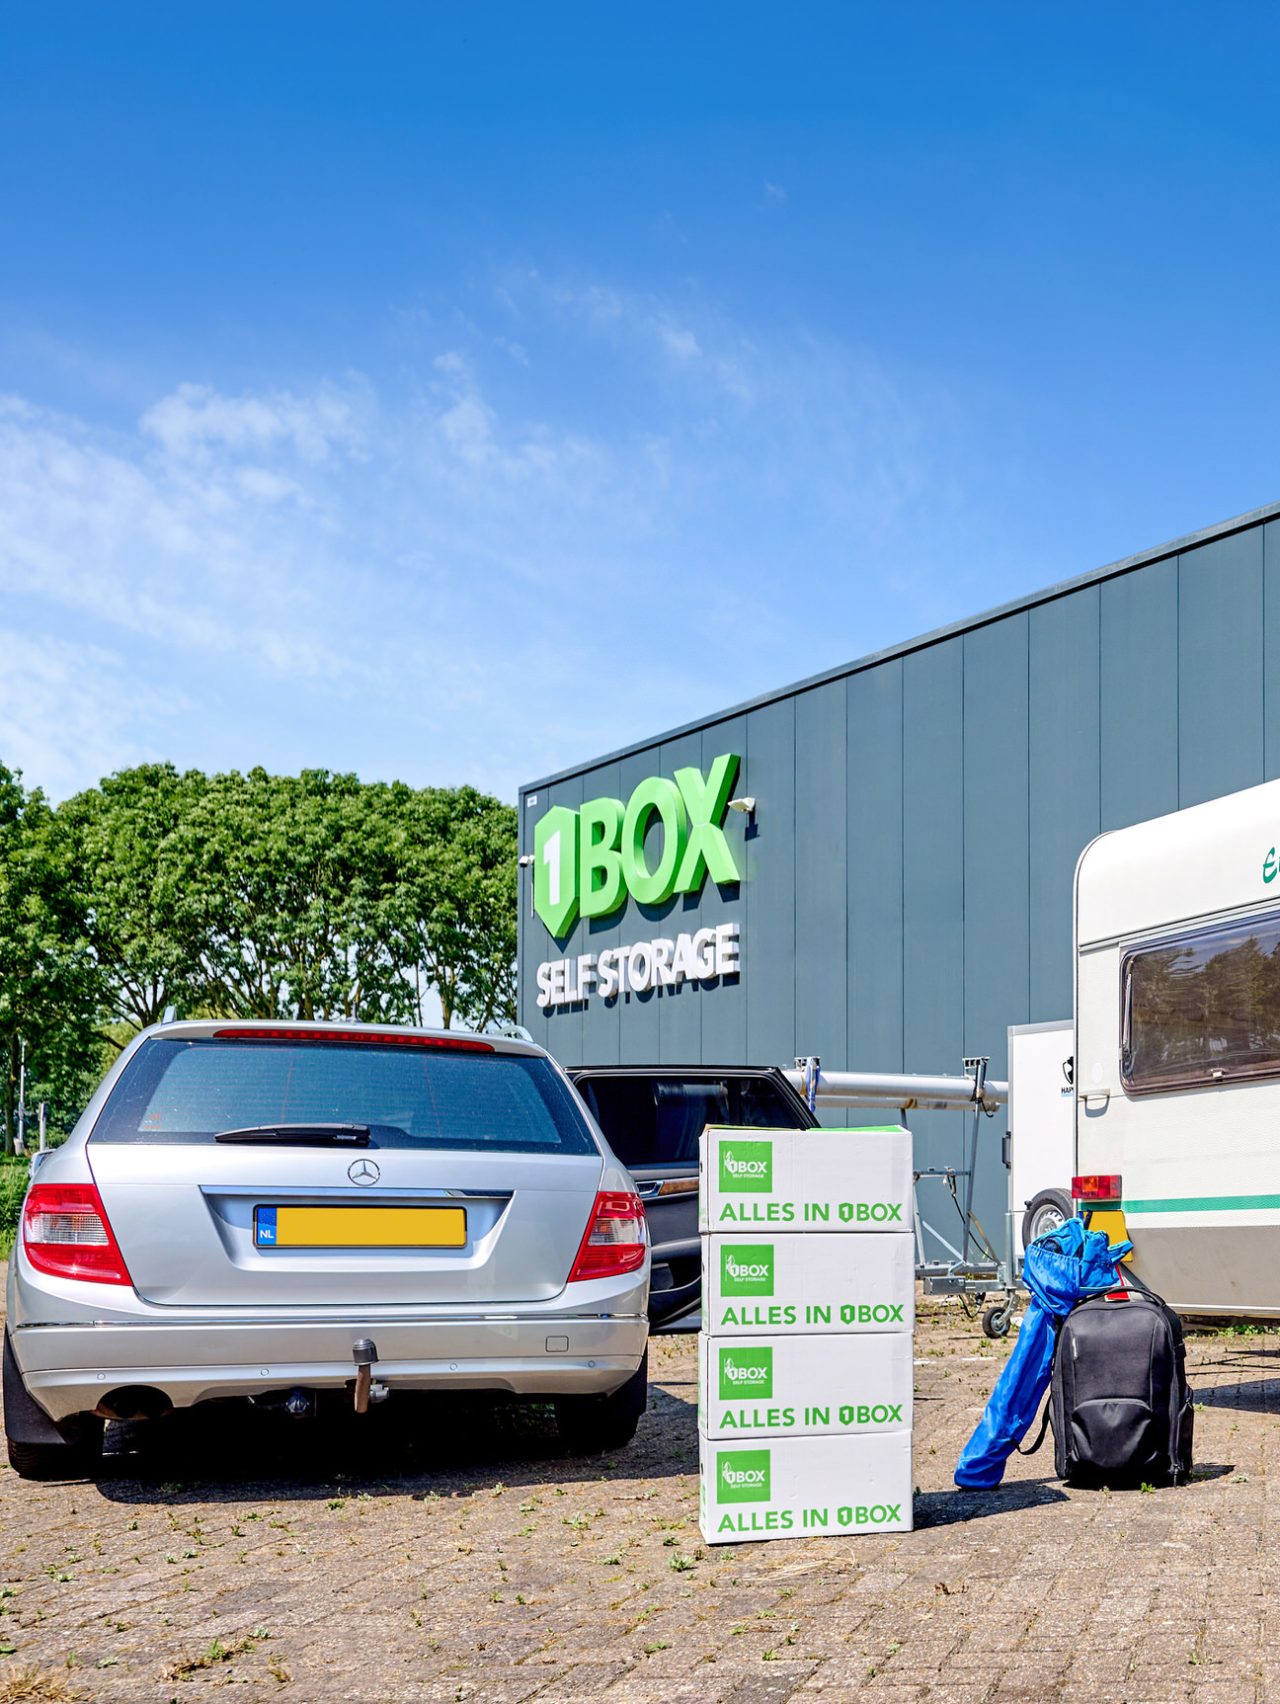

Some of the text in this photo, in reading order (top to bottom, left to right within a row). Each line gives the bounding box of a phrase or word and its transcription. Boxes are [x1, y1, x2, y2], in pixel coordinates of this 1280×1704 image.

[535, 754, 741, 938] 1BOX
[536, 923, 741, 1007] SELF STORAGE
[719, 1201, 902, 1223] ALLES IN 1BOX
[260, 1229, 275, 1239] NL
[721, 1304, 904, 1326] ALLES IN 1BOX
[719, 1404, 903, 1429] ALLES IN 1BOX
[717, 1504, 901, 1533] ALLES IN 1BOX
